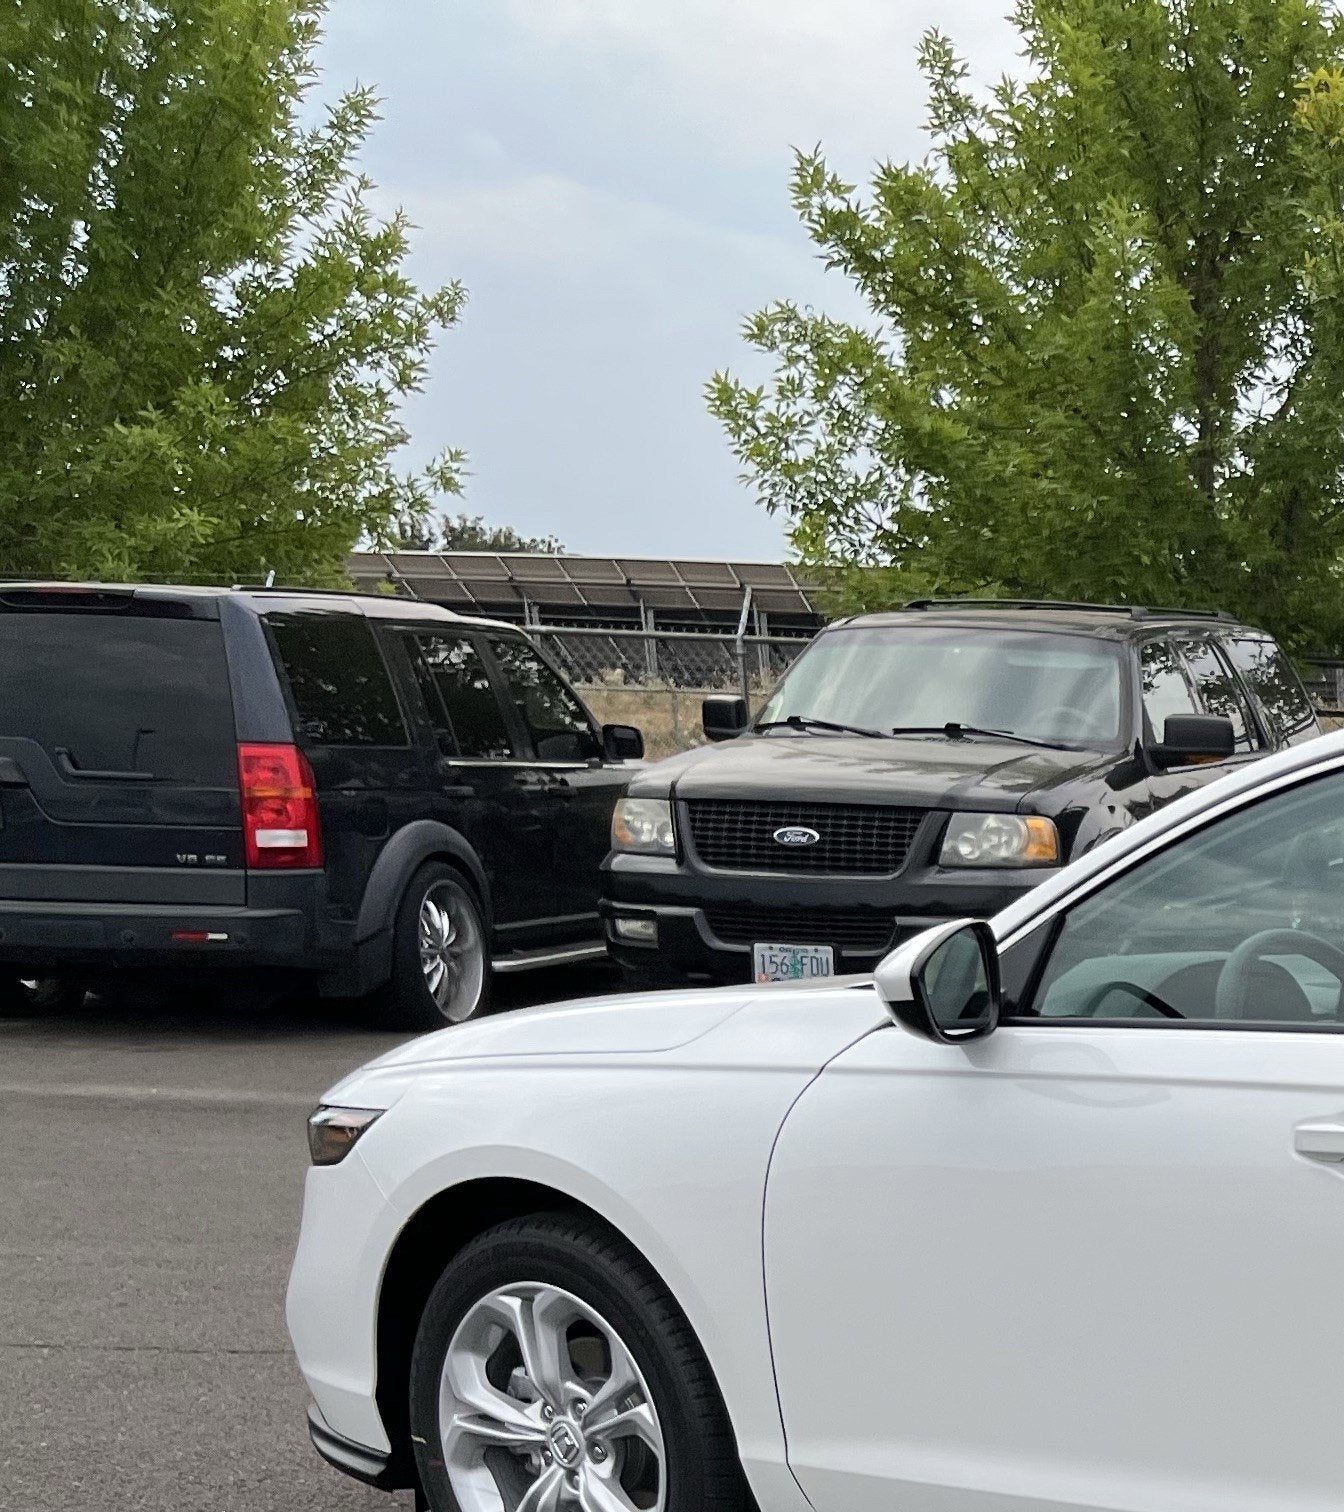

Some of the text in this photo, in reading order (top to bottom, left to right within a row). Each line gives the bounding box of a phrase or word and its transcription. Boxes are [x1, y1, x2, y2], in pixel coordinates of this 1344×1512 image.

[784, 831, 809, 843] Ford
[760, 953, 830, 977] 156 FDU
